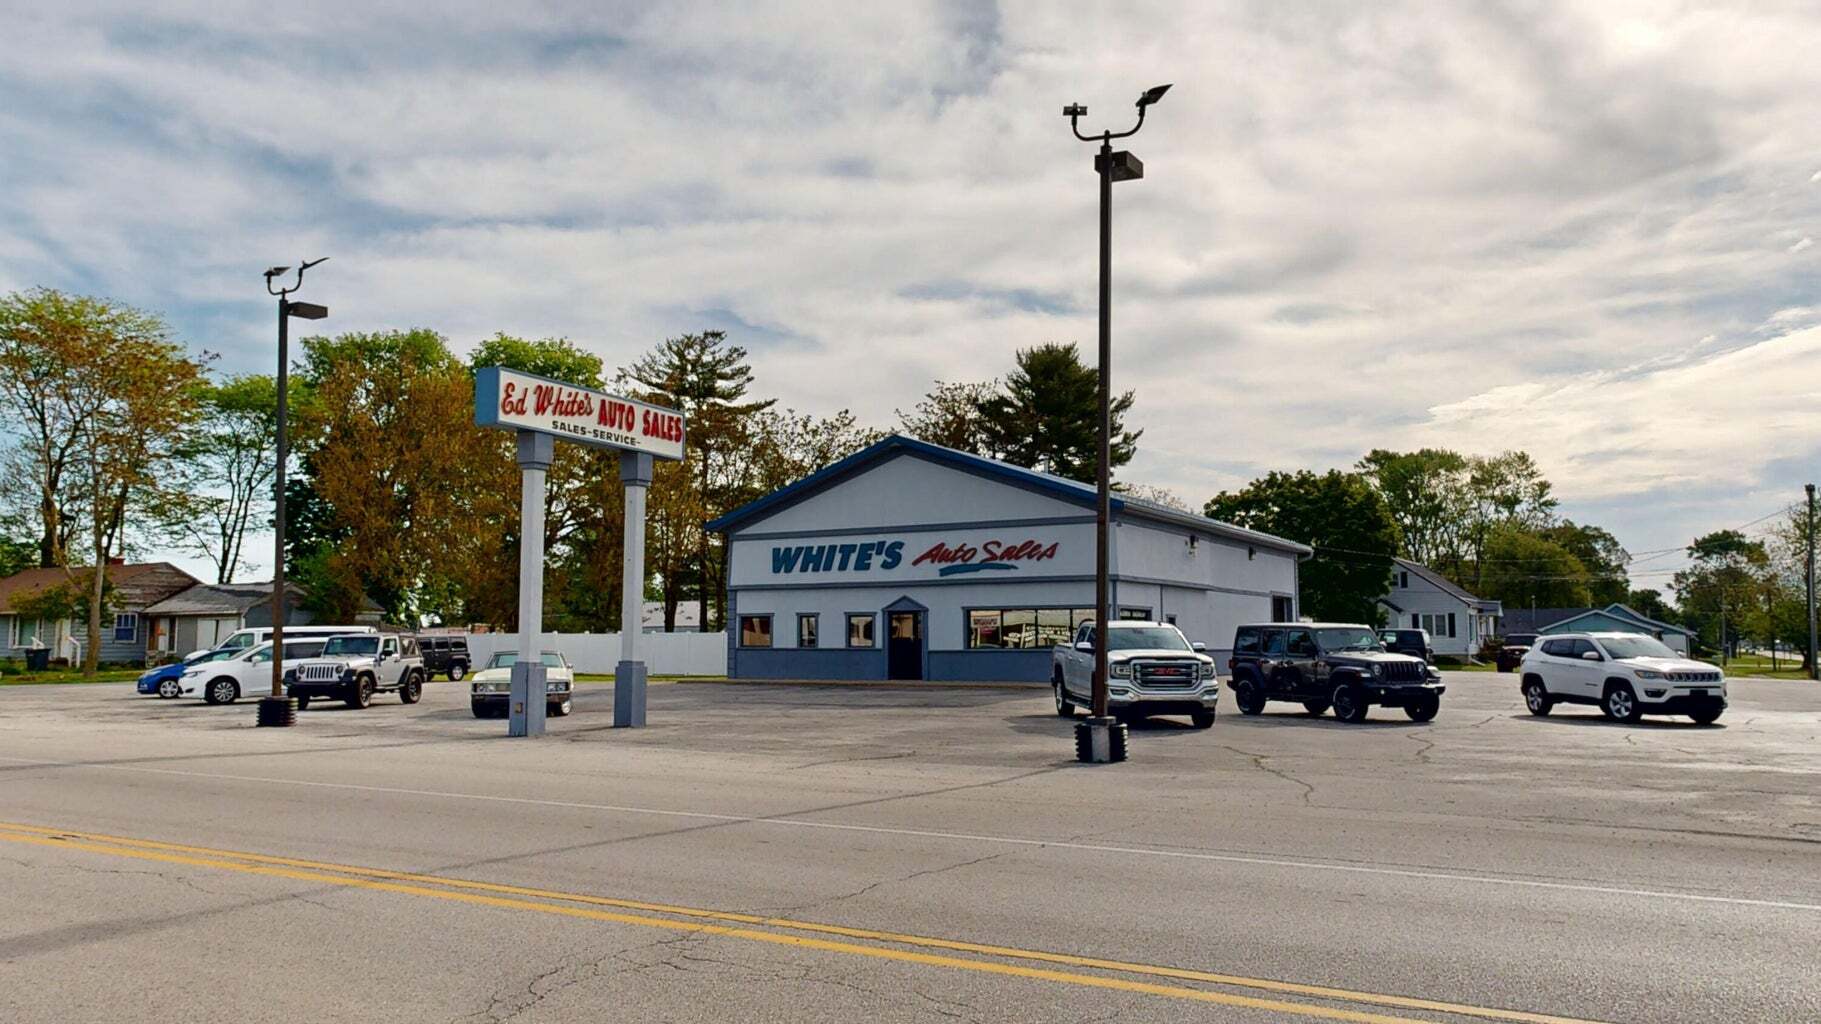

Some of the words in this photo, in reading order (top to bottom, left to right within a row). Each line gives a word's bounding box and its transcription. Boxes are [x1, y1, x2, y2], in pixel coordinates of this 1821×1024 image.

[501, 382, 528, 415] Ed
[534, 384, 594, 417] White's
[598, 399, 635, 432] AUTO
[642, 410, 682, 442] SALES
[771, 541, 905, 574] WHITE'S
[912, 543, 977, 566] Auto
[980, 540, 1060, 564] Sales
